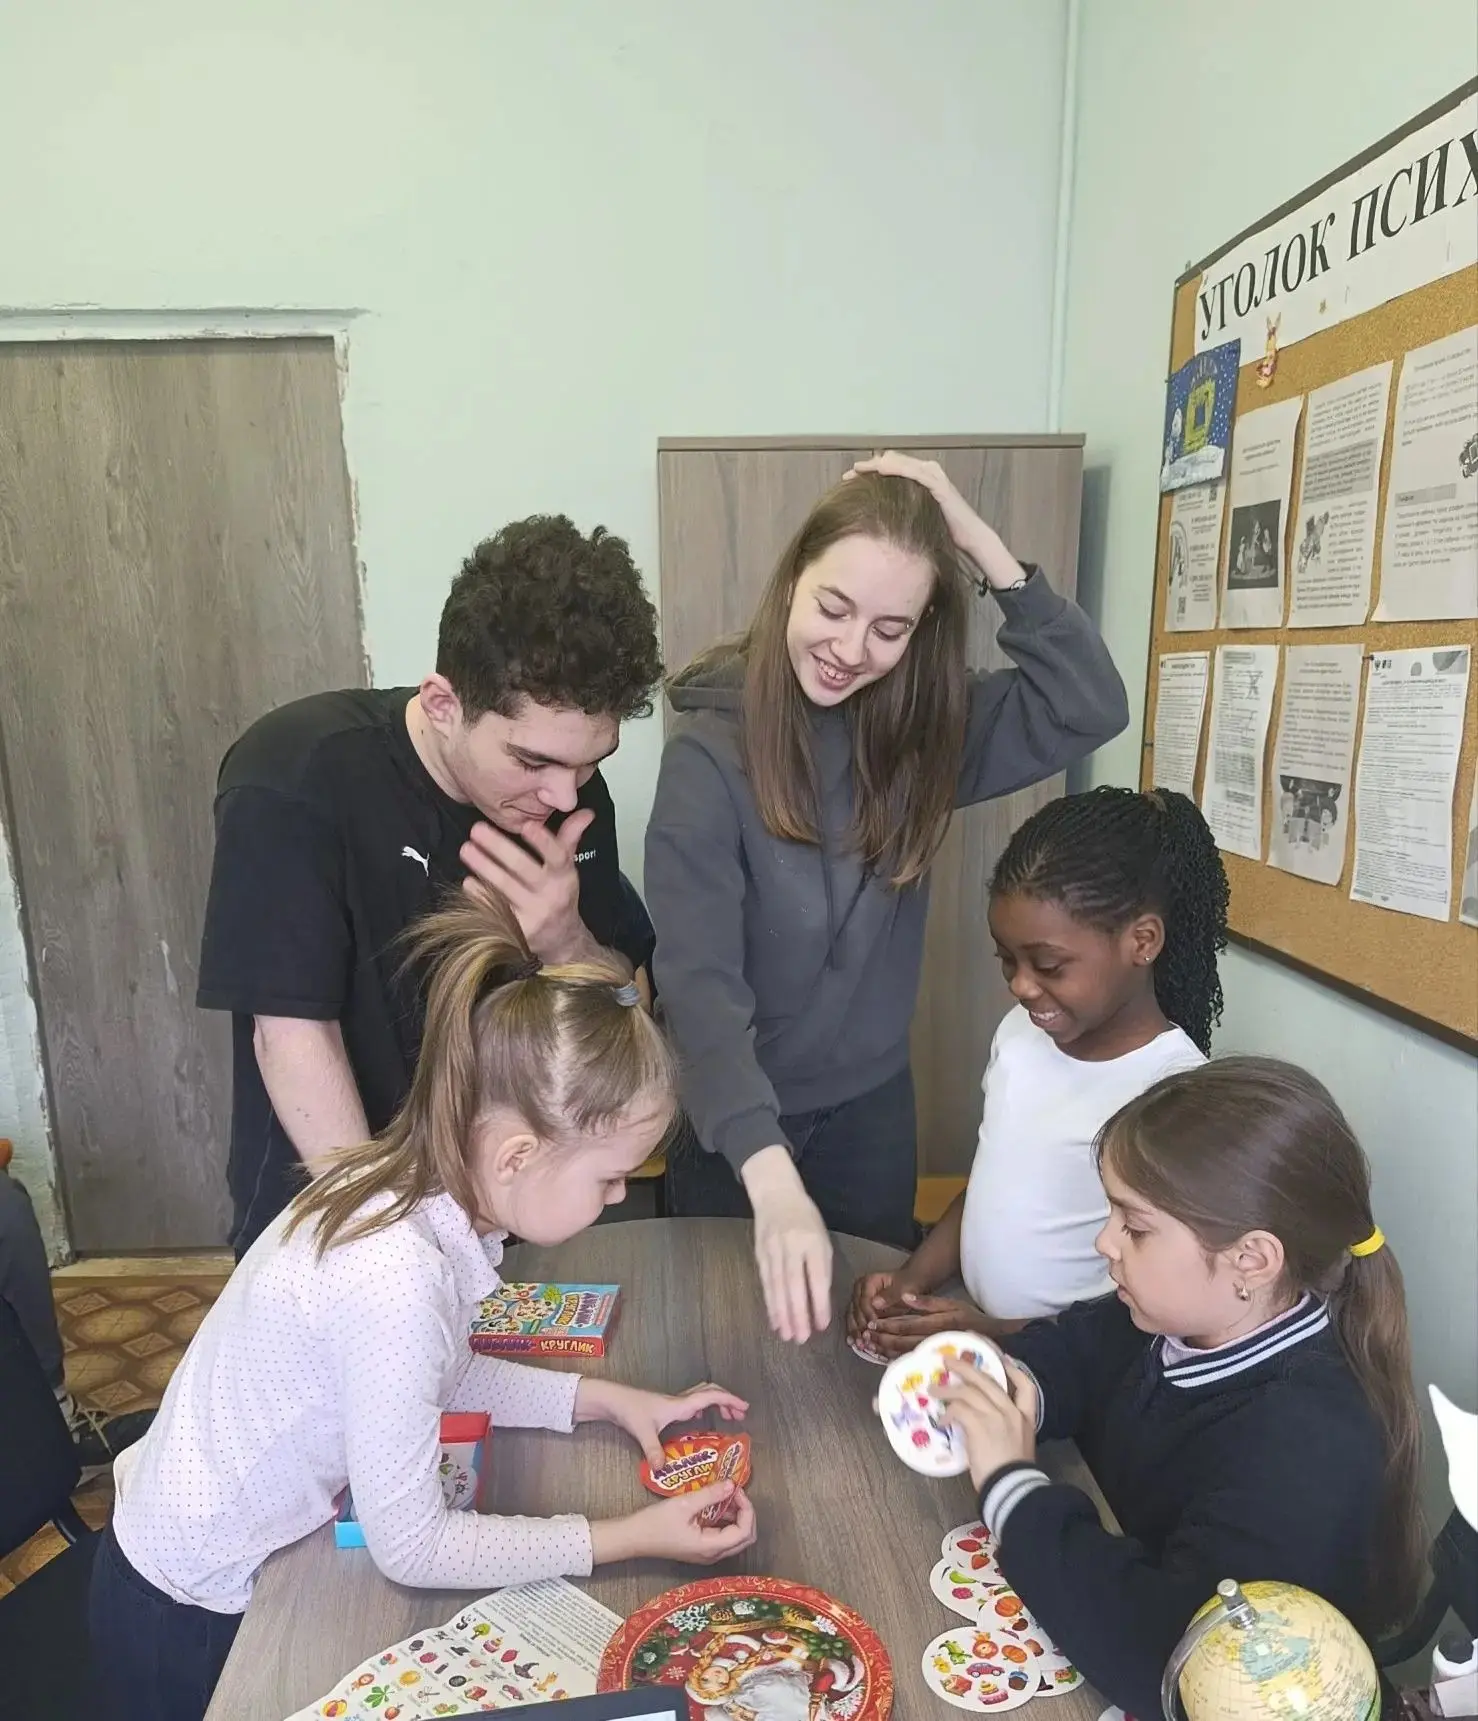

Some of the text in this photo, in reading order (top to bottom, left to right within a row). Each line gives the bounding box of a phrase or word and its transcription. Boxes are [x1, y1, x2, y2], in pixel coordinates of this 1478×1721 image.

[1199, 211, 1336, 340] УГОЛОК
[540, 1339, 596, 1355] КРУГЛИК
[660, 1462, 714, 1487] КРУГЛИ
